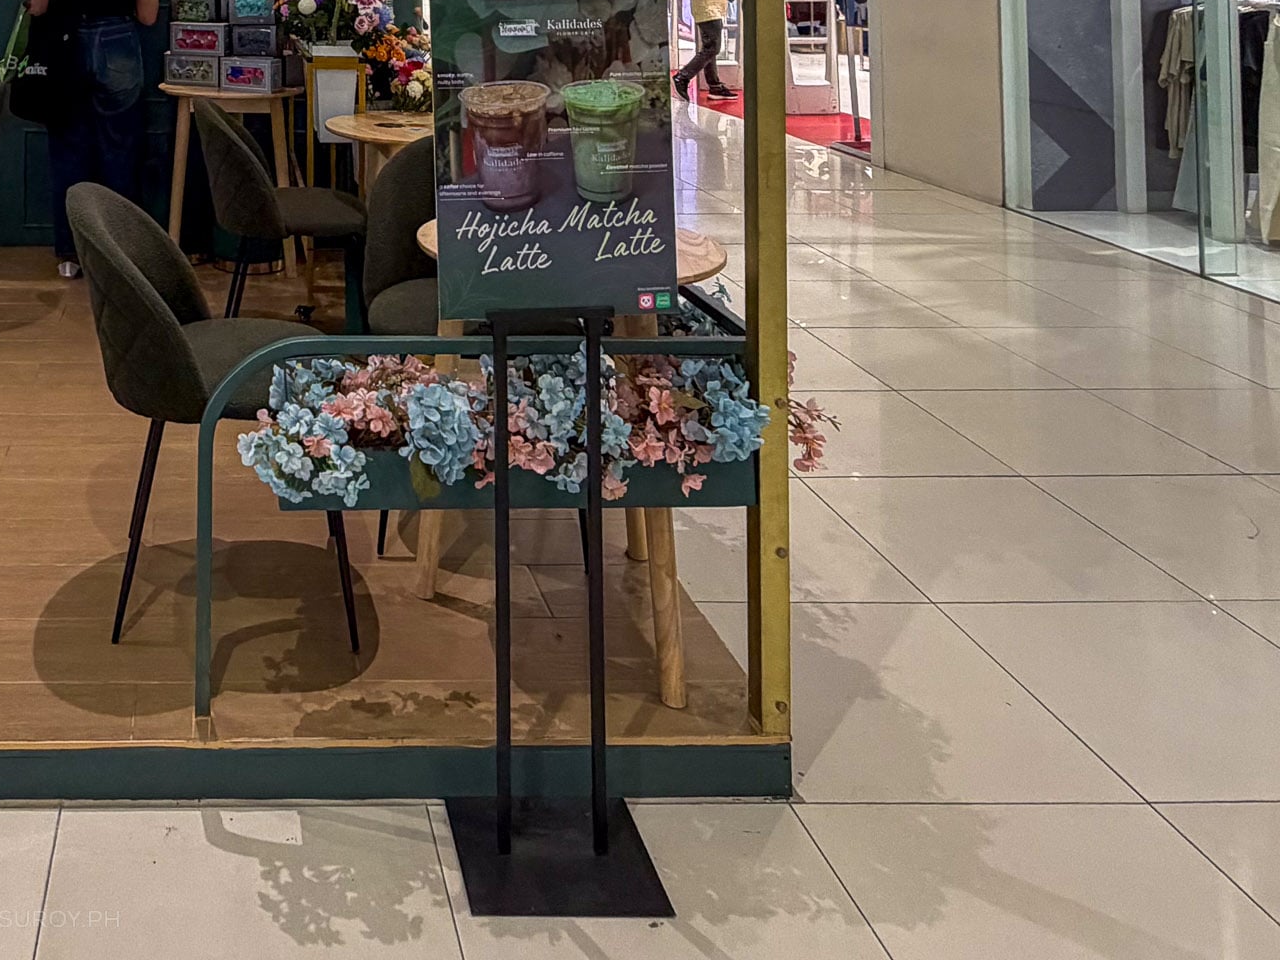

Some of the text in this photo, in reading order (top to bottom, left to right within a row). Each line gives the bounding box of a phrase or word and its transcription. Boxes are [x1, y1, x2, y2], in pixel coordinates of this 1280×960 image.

[456, 207, 553, 253] Hojicha
[557, 197, 658, 233] Matcha
[480, 242, 553, 276] Latte
[594, 227, 666, 262] Latte
